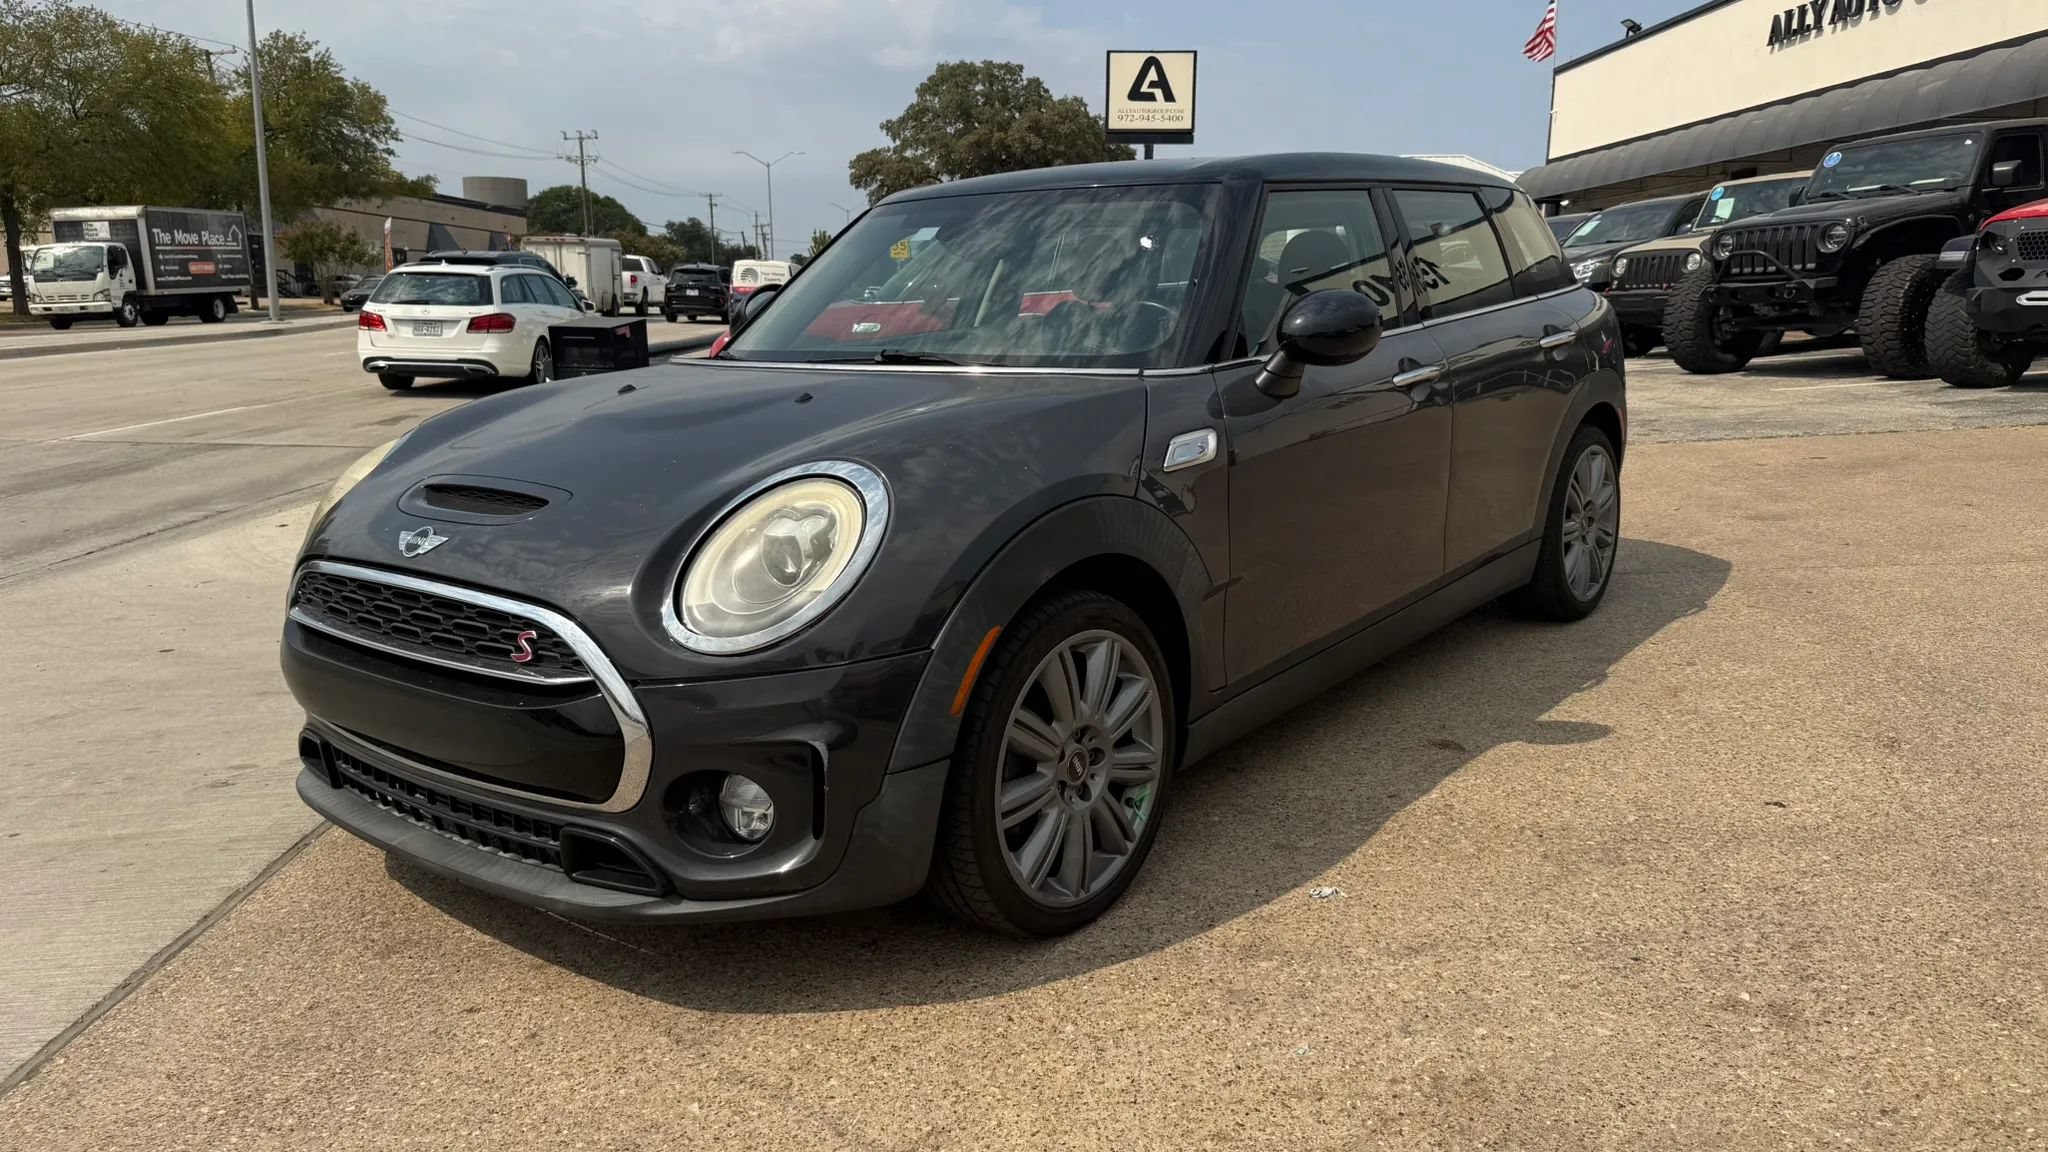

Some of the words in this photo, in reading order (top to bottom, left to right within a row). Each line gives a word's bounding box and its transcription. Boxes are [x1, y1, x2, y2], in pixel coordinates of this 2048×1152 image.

[1766, 0, 1829, 47] ALLY
[1828, 0, 1899, 26] AU
[1117, 114, 1184, 122] 972-945-5400
[152, 228, 171, 244] The
[174, 229, 199, 245] Move
[201, 230, 225, 246] Place
[510, 630, 537, 663] S
